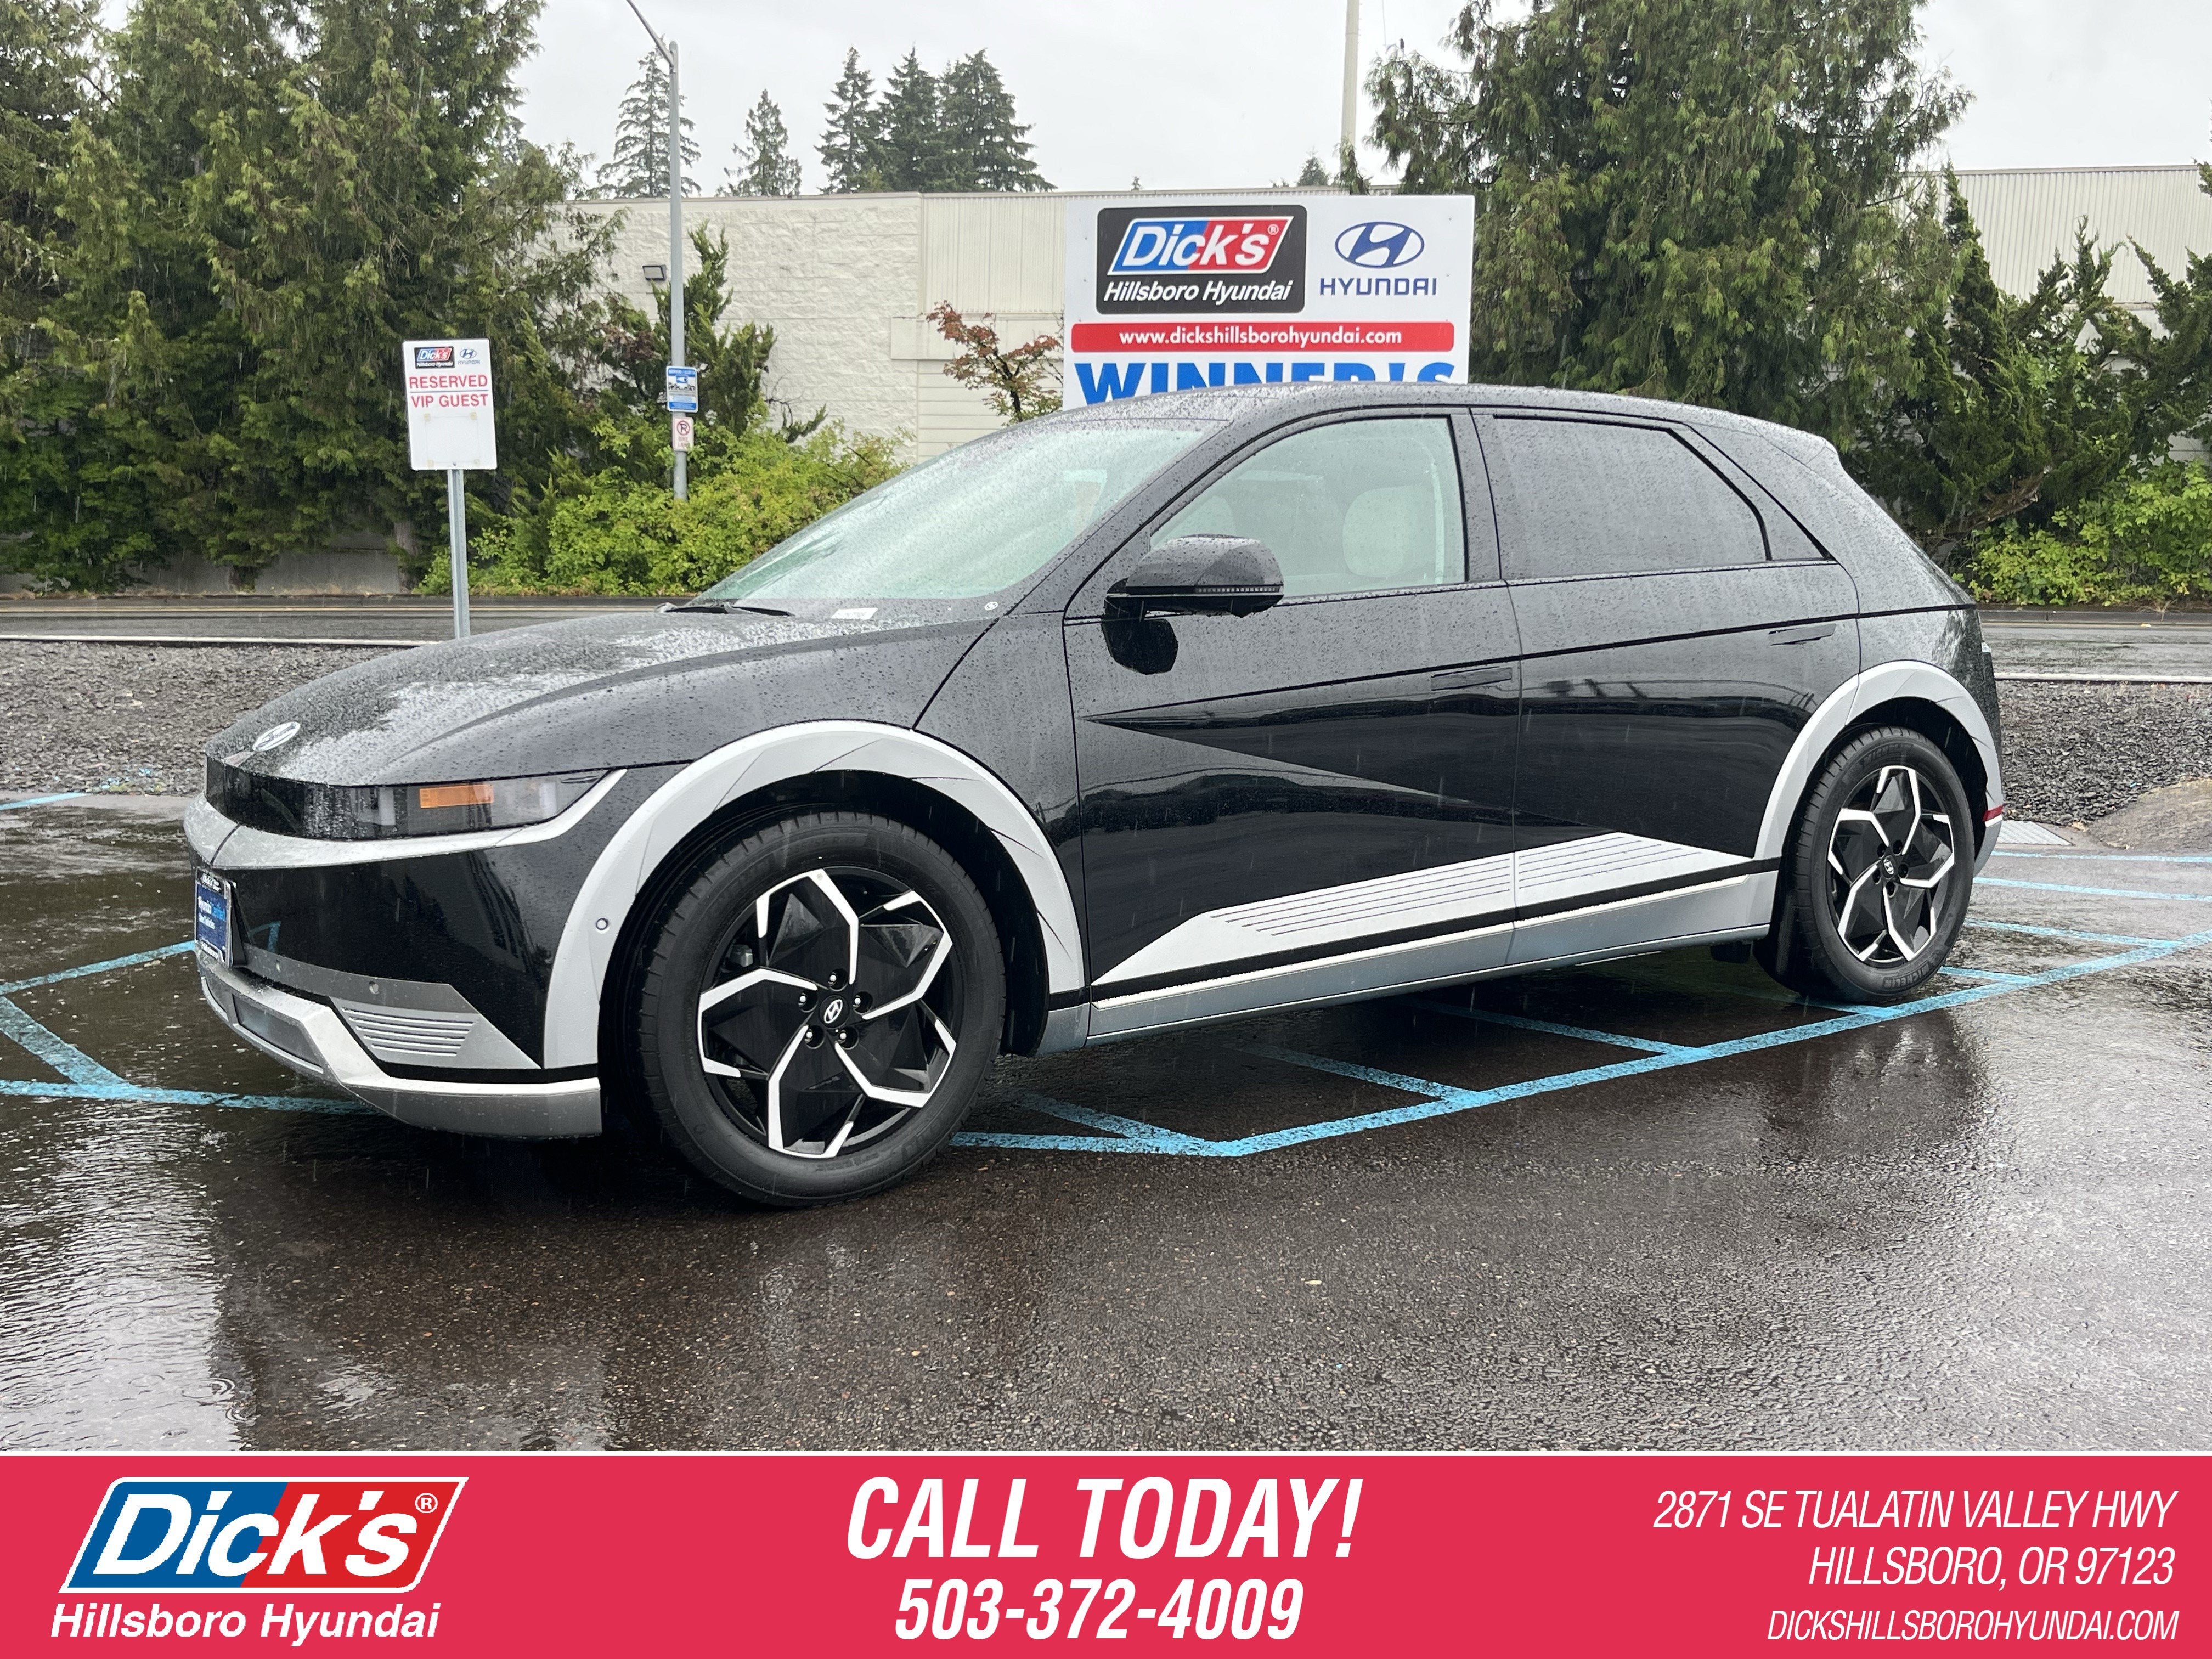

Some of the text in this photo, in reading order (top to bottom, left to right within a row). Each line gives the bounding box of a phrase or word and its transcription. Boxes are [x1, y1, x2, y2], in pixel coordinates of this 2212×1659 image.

[1122, 223, 1269, 267] Dick's
[1103, 280, 1293, 305] Hillsboro Hyundai
[1320, 278, 1436, 296] HYUNDAI
[1119, 326, 1402, 348] www.dickshillsborohyundai.com
[409, 375, 488, 388] RESERVED
[411, 394, 488, 408] VIP GUEST
